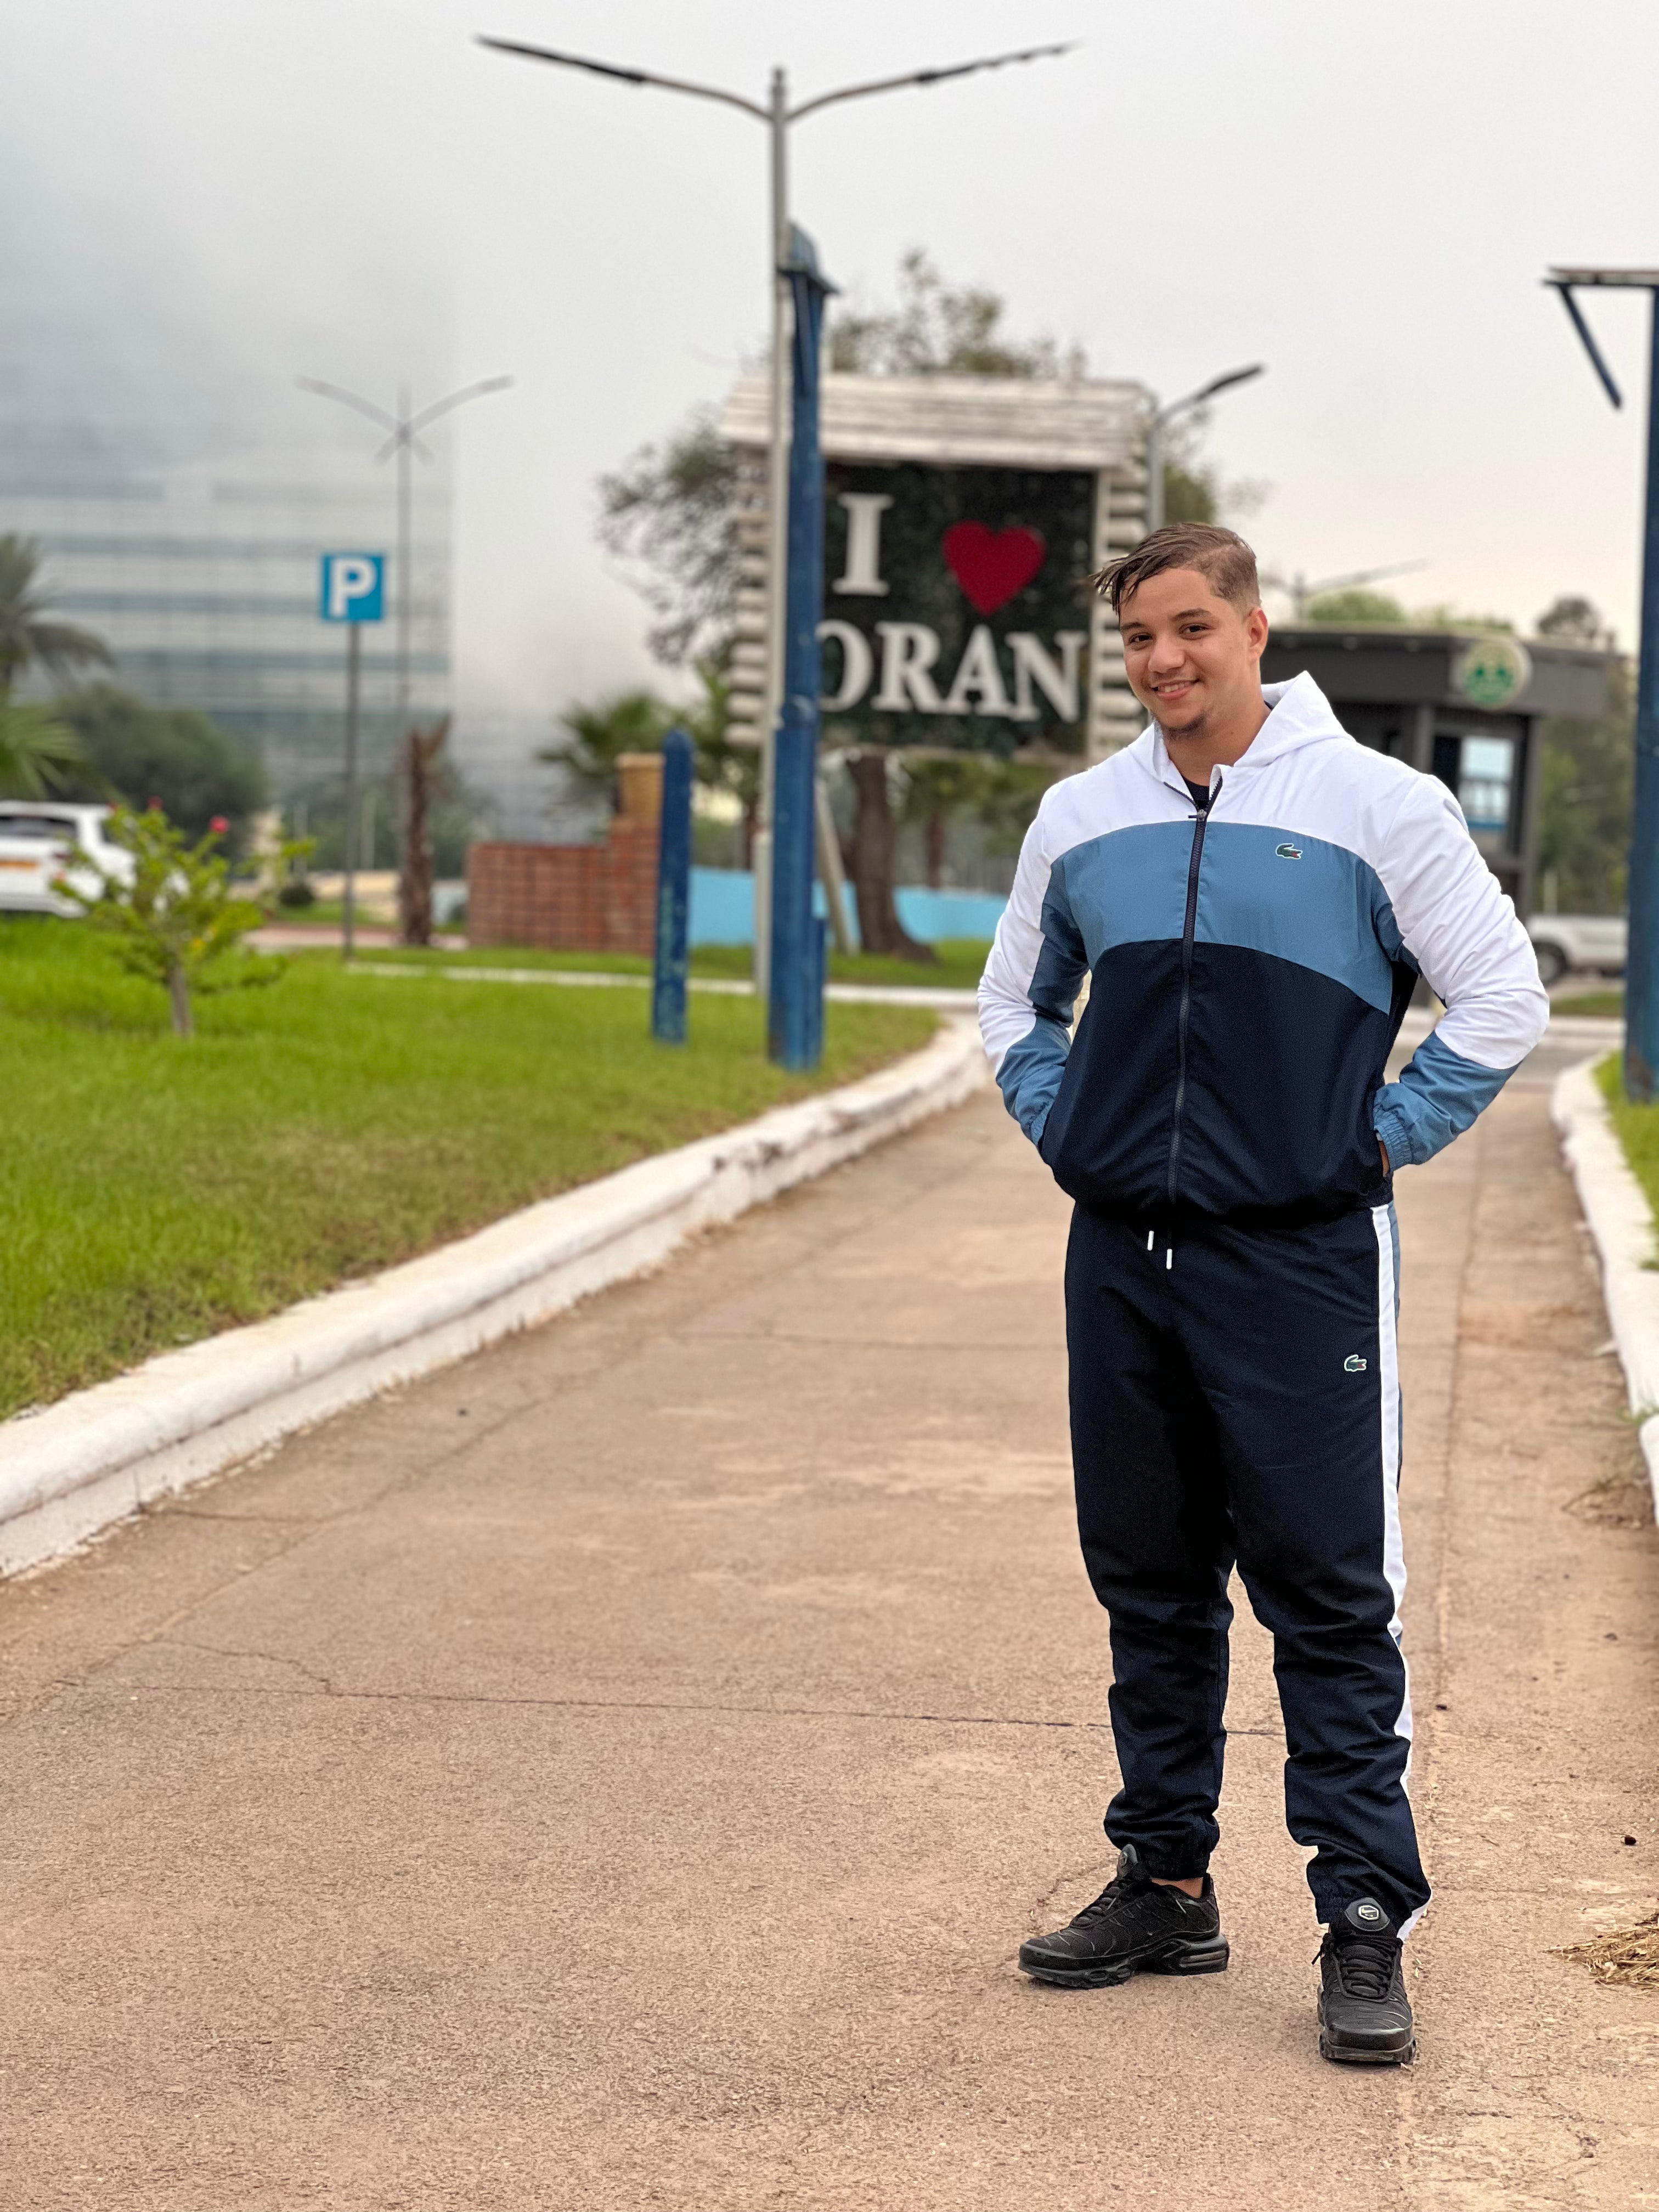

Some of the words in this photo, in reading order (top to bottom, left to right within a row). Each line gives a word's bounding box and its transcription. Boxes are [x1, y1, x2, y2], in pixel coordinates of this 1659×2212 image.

[330, 560, 377, 616] P
[832, 493, 893, 597] I
[815, 619, 1087, 723] ORAN
